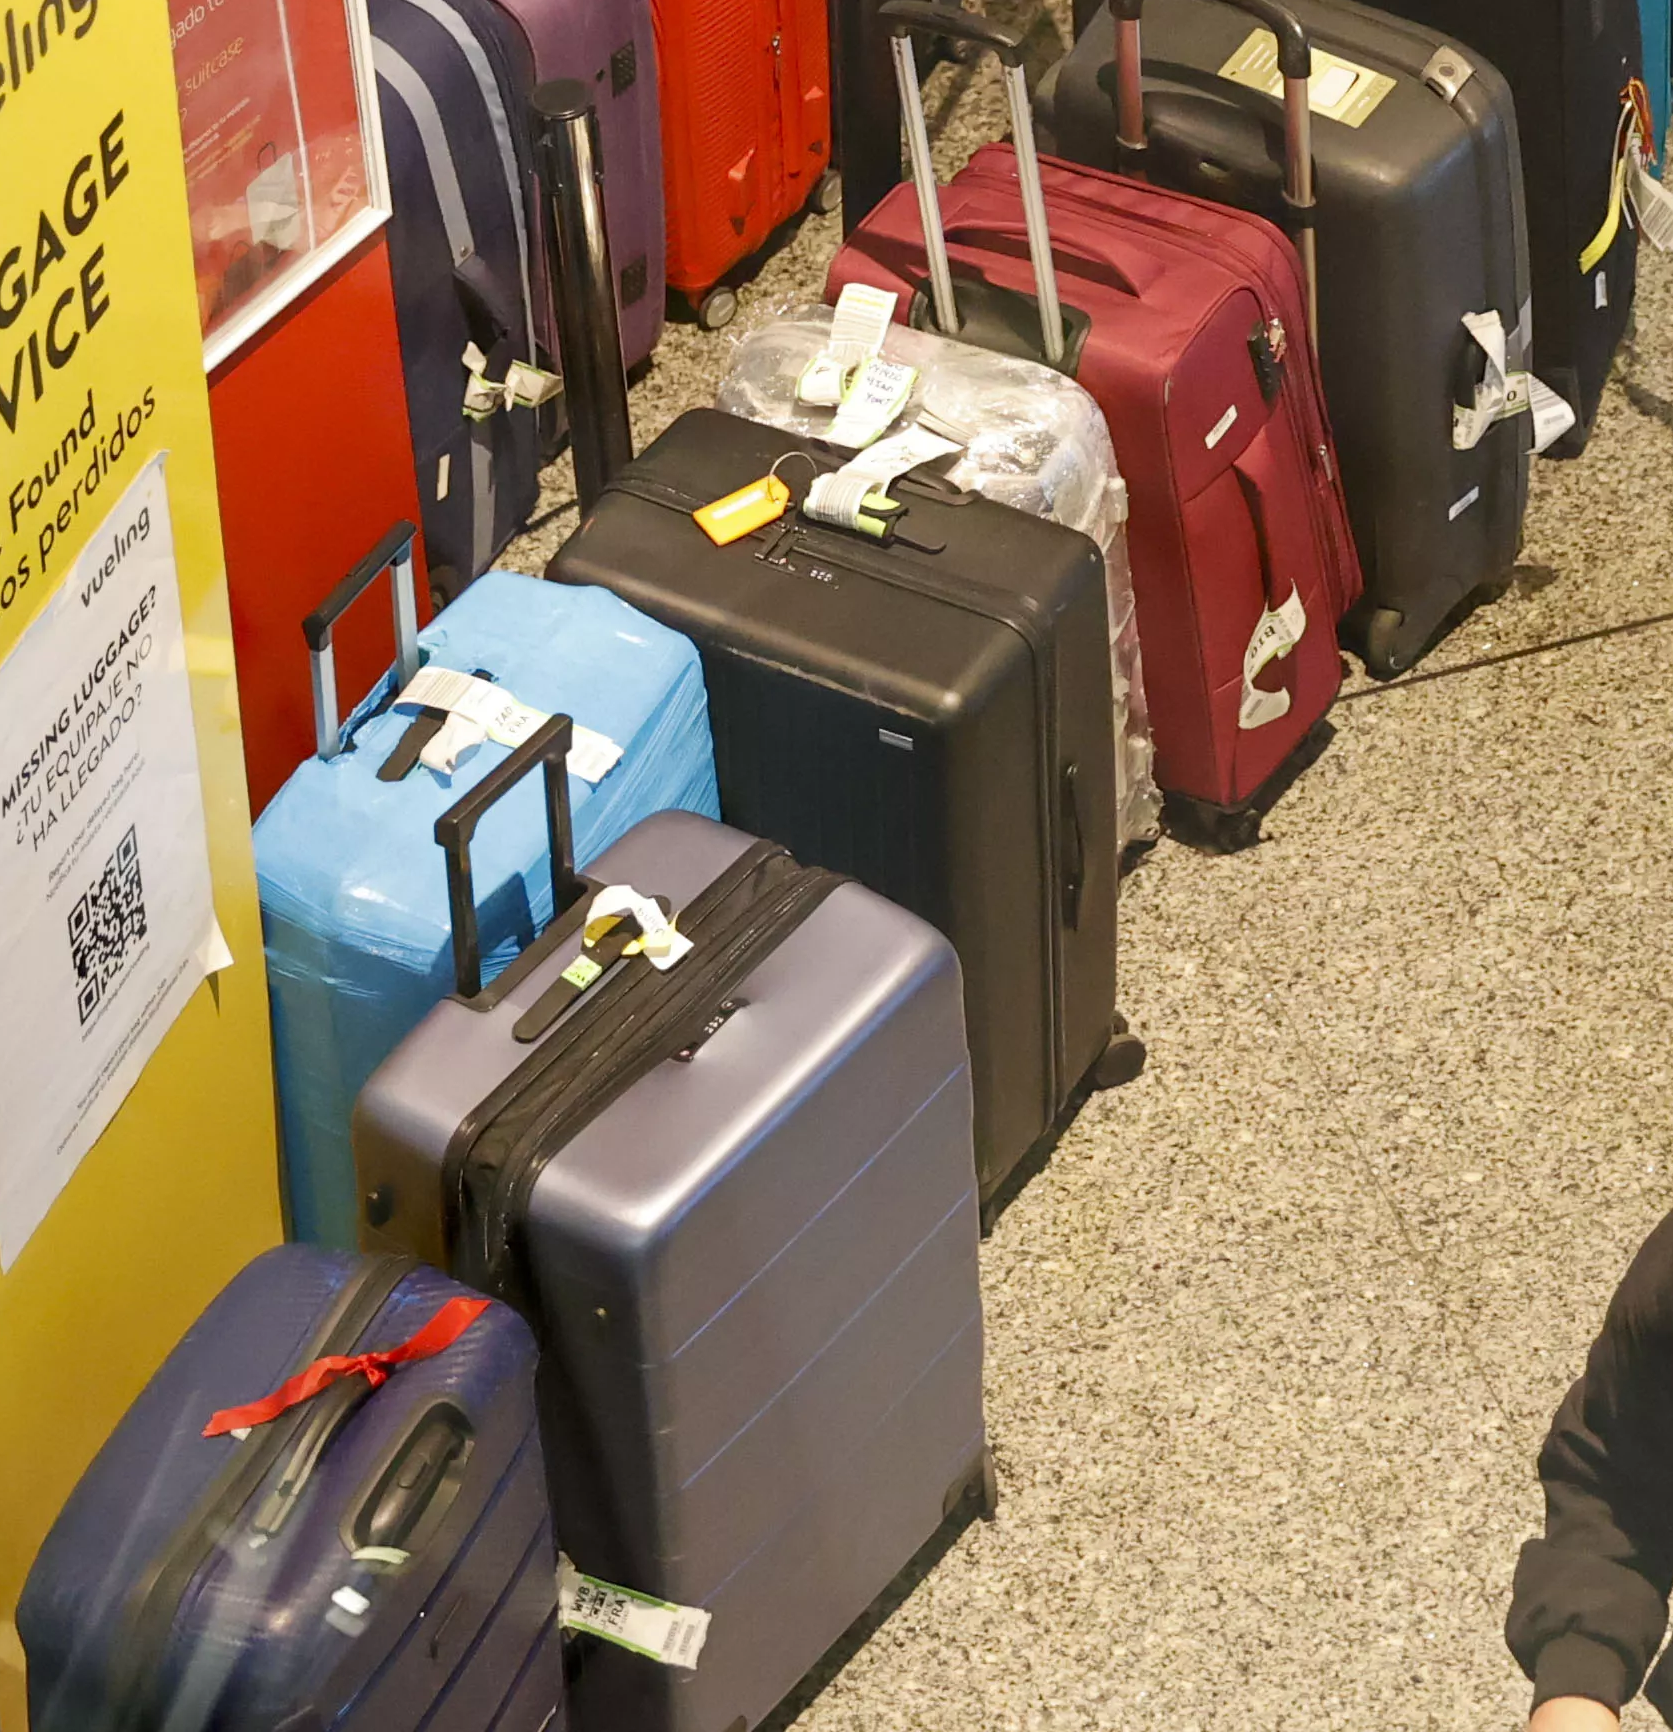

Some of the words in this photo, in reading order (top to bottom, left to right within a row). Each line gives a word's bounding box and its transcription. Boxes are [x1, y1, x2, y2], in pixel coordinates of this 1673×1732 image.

[168, 5, 206, 50] gado
[183, 35, 245, 97] suitcase
[9, 388, 97, 534] Found
[39, 385, 157, 573] perdidos
[80, 506, 151, 609] vueling
[0, 703, 70, 819] MISSING
[72, 581, 157, 717] LUGGAGE?
[1250, 623, 1277, 659] BIO
[13, 782, 43, 848] ¿TU
[44, 667, 124, 798] EQUIPAJE
[125, 627, 153, 682] NO
[32, 801, 57, 853] HA
[59, 679, 144, 815] LLEGADO?
[608, 1598, 627, 1626] FRA
